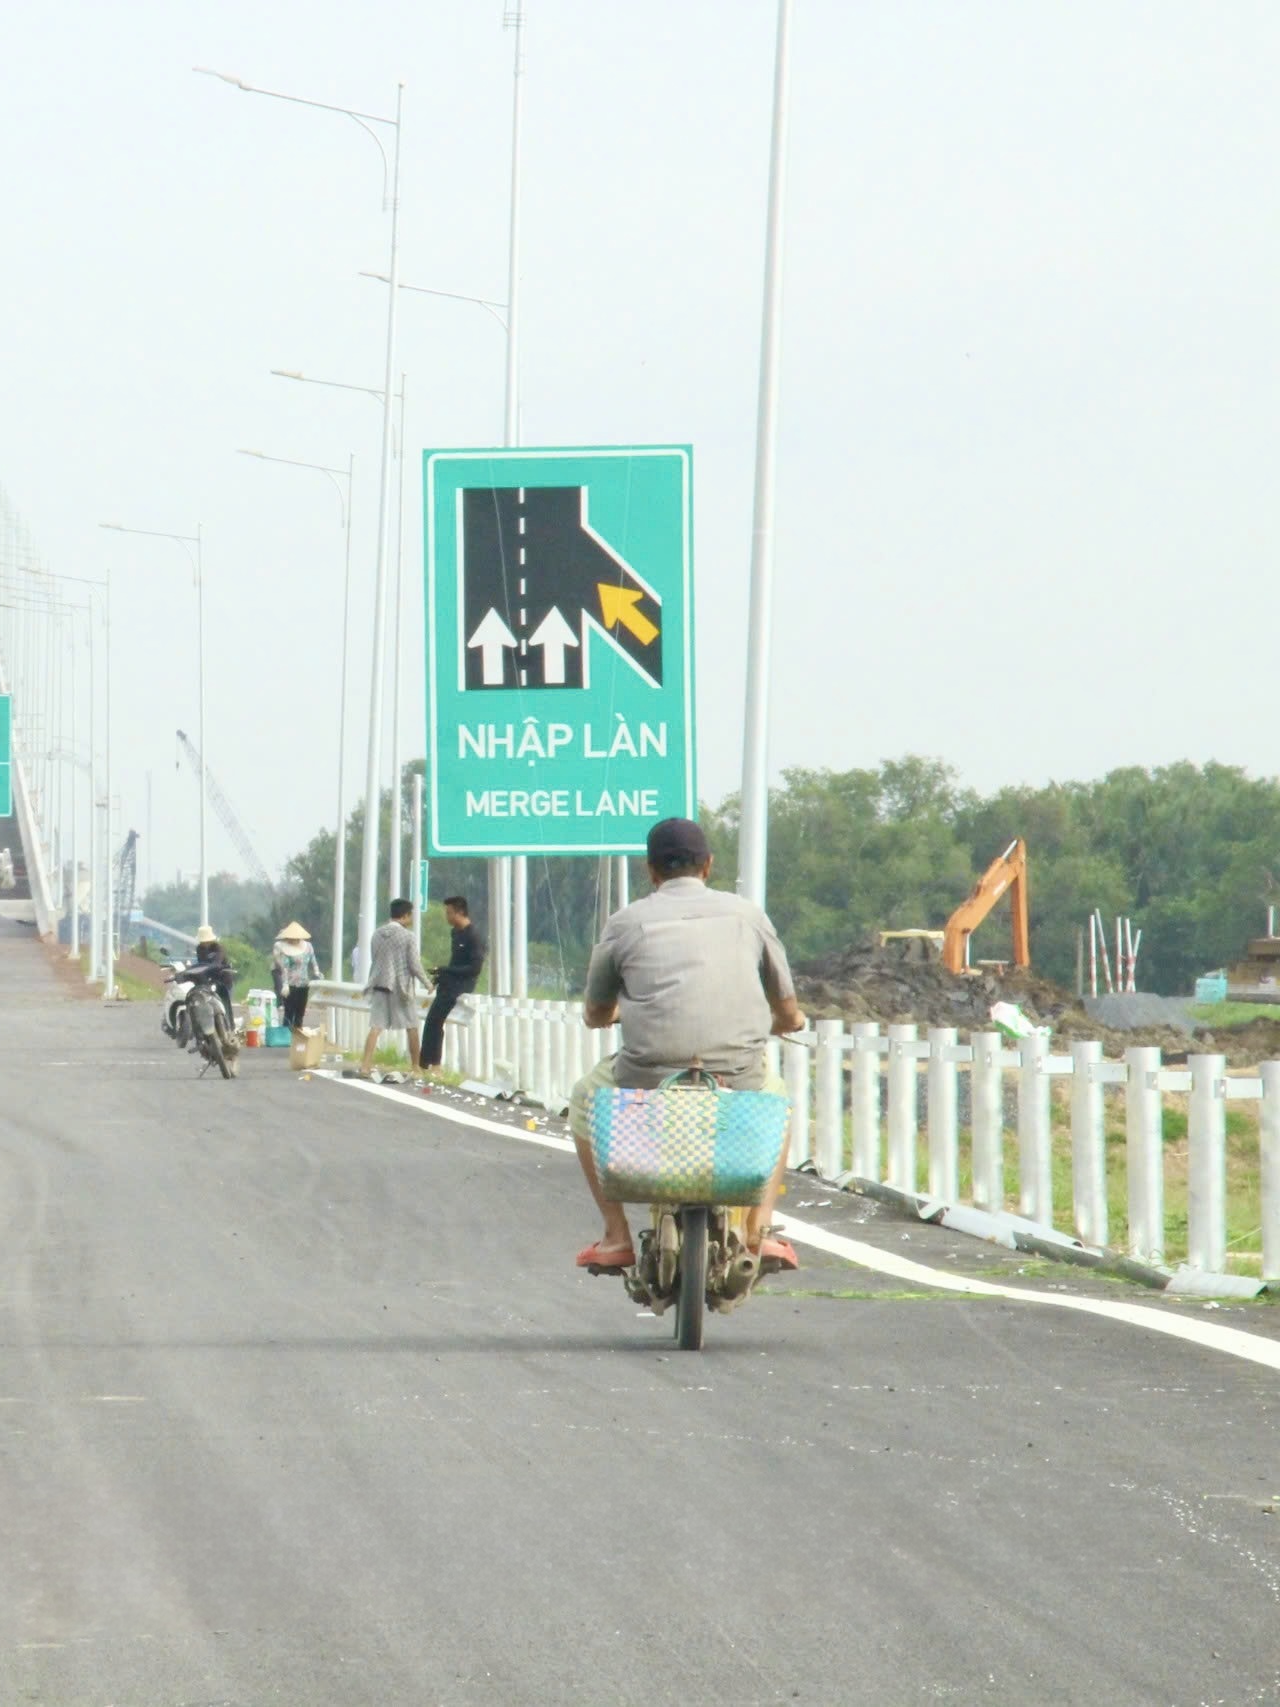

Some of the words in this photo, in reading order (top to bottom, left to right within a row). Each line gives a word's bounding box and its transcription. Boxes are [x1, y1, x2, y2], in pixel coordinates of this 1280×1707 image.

[458, 717, 573, 767] NHẬP
[584, 713, 667, 759] LÀN
[466, 791, 569, 817] MERGE
[577, 789, 659, 816] LANE
